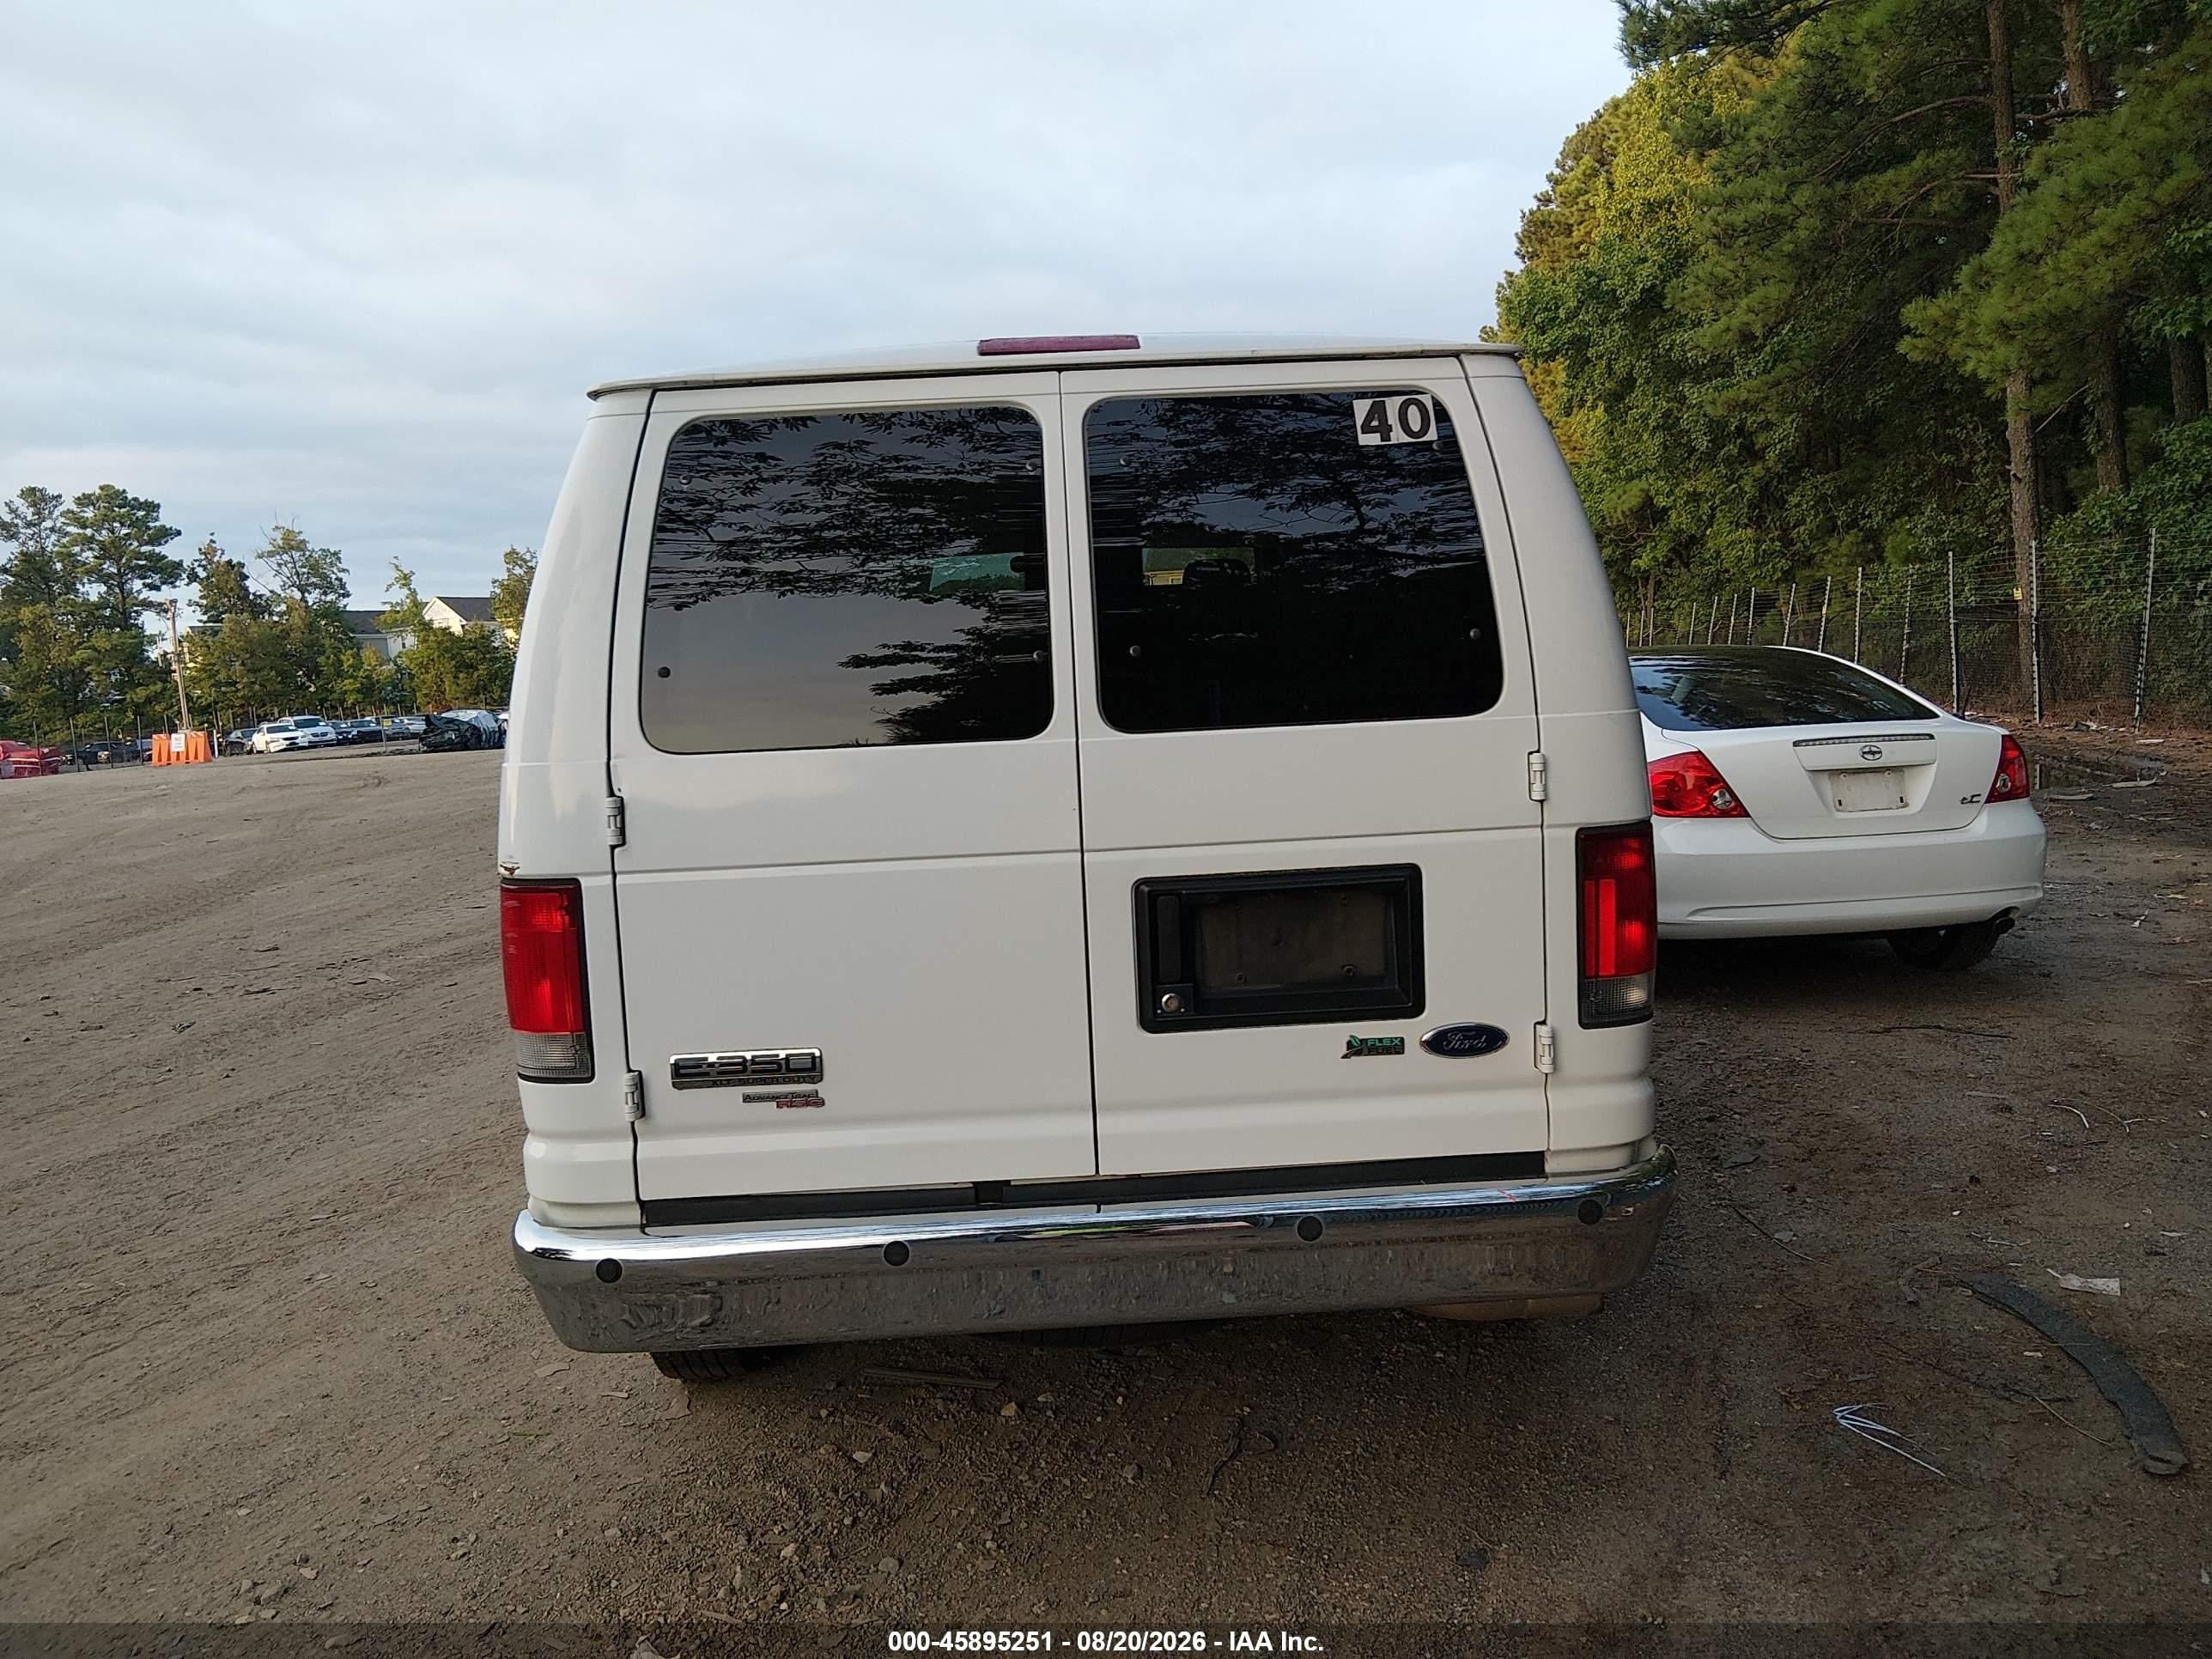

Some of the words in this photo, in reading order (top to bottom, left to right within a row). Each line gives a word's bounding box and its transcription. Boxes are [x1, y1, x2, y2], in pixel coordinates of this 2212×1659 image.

[1360, 398, 1431, 442] 40
[1367, 1037, 1402, 1047] FLEX
[1443, 1030, 1486, 1050] Ford
[738, 1077, 779, 1085] SUPER
[782, 1075, 816, 1085] DUTY
